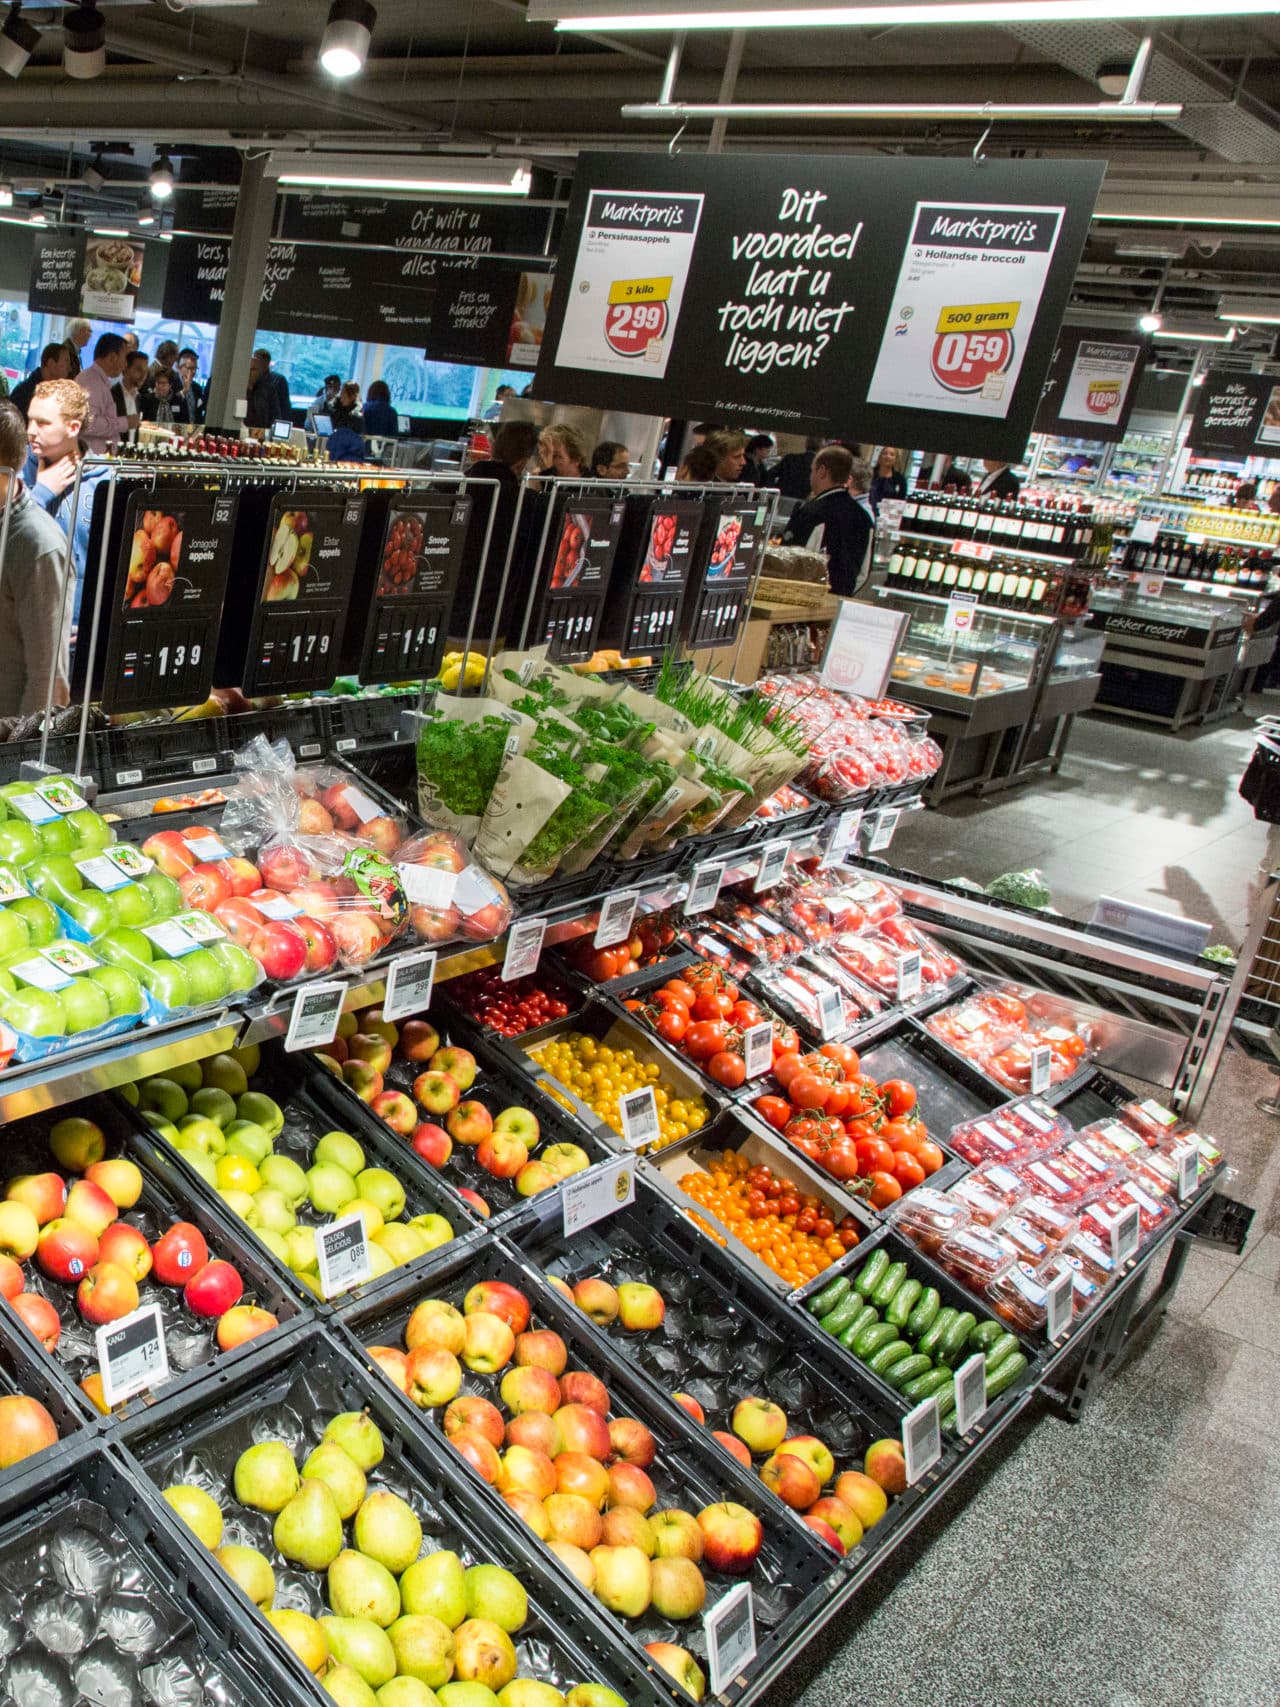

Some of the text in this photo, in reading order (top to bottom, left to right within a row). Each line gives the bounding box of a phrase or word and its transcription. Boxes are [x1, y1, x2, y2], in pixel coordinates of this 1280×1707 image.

[601, 202, 684, 227] Marktprijs
[778, 188, 828, 223] Dit
[411, 207, 480, 232] Of wilt u
[598, 231, 670, 244] Perssinaasappels
[930, 216, 1038, 245] Marktprijs
[463, 234, 492, 253] van
[732, 221, 864, 261] voordeel
[197, 243, 224, 262] Vers,
[925, 250, 1025, 266] Hollandse broccoli
[197, 266, 227, 280] maar
[401, 255, 436, 277] alles
[745, 261, 832, 297] laat u
[475, 292, 490, 302] en
[626, 285, 654, 296] 3 kilo
[609, 305, 661, 339] 2.99
[718, 297, 855, 333] toch niet
[946, 312, 1010, 325] 500 gram
[725, 332, 830, 374] liggen?
[937, 334, 1003, 372] 0.59
[216, 510, 229, 522] 92
[188, 538, 218, 550] Jonagold
[318, 548, 341, 558] appels
[188, 550, 215, 562] appels
[1105, 616, 1145, 631] Lekker
